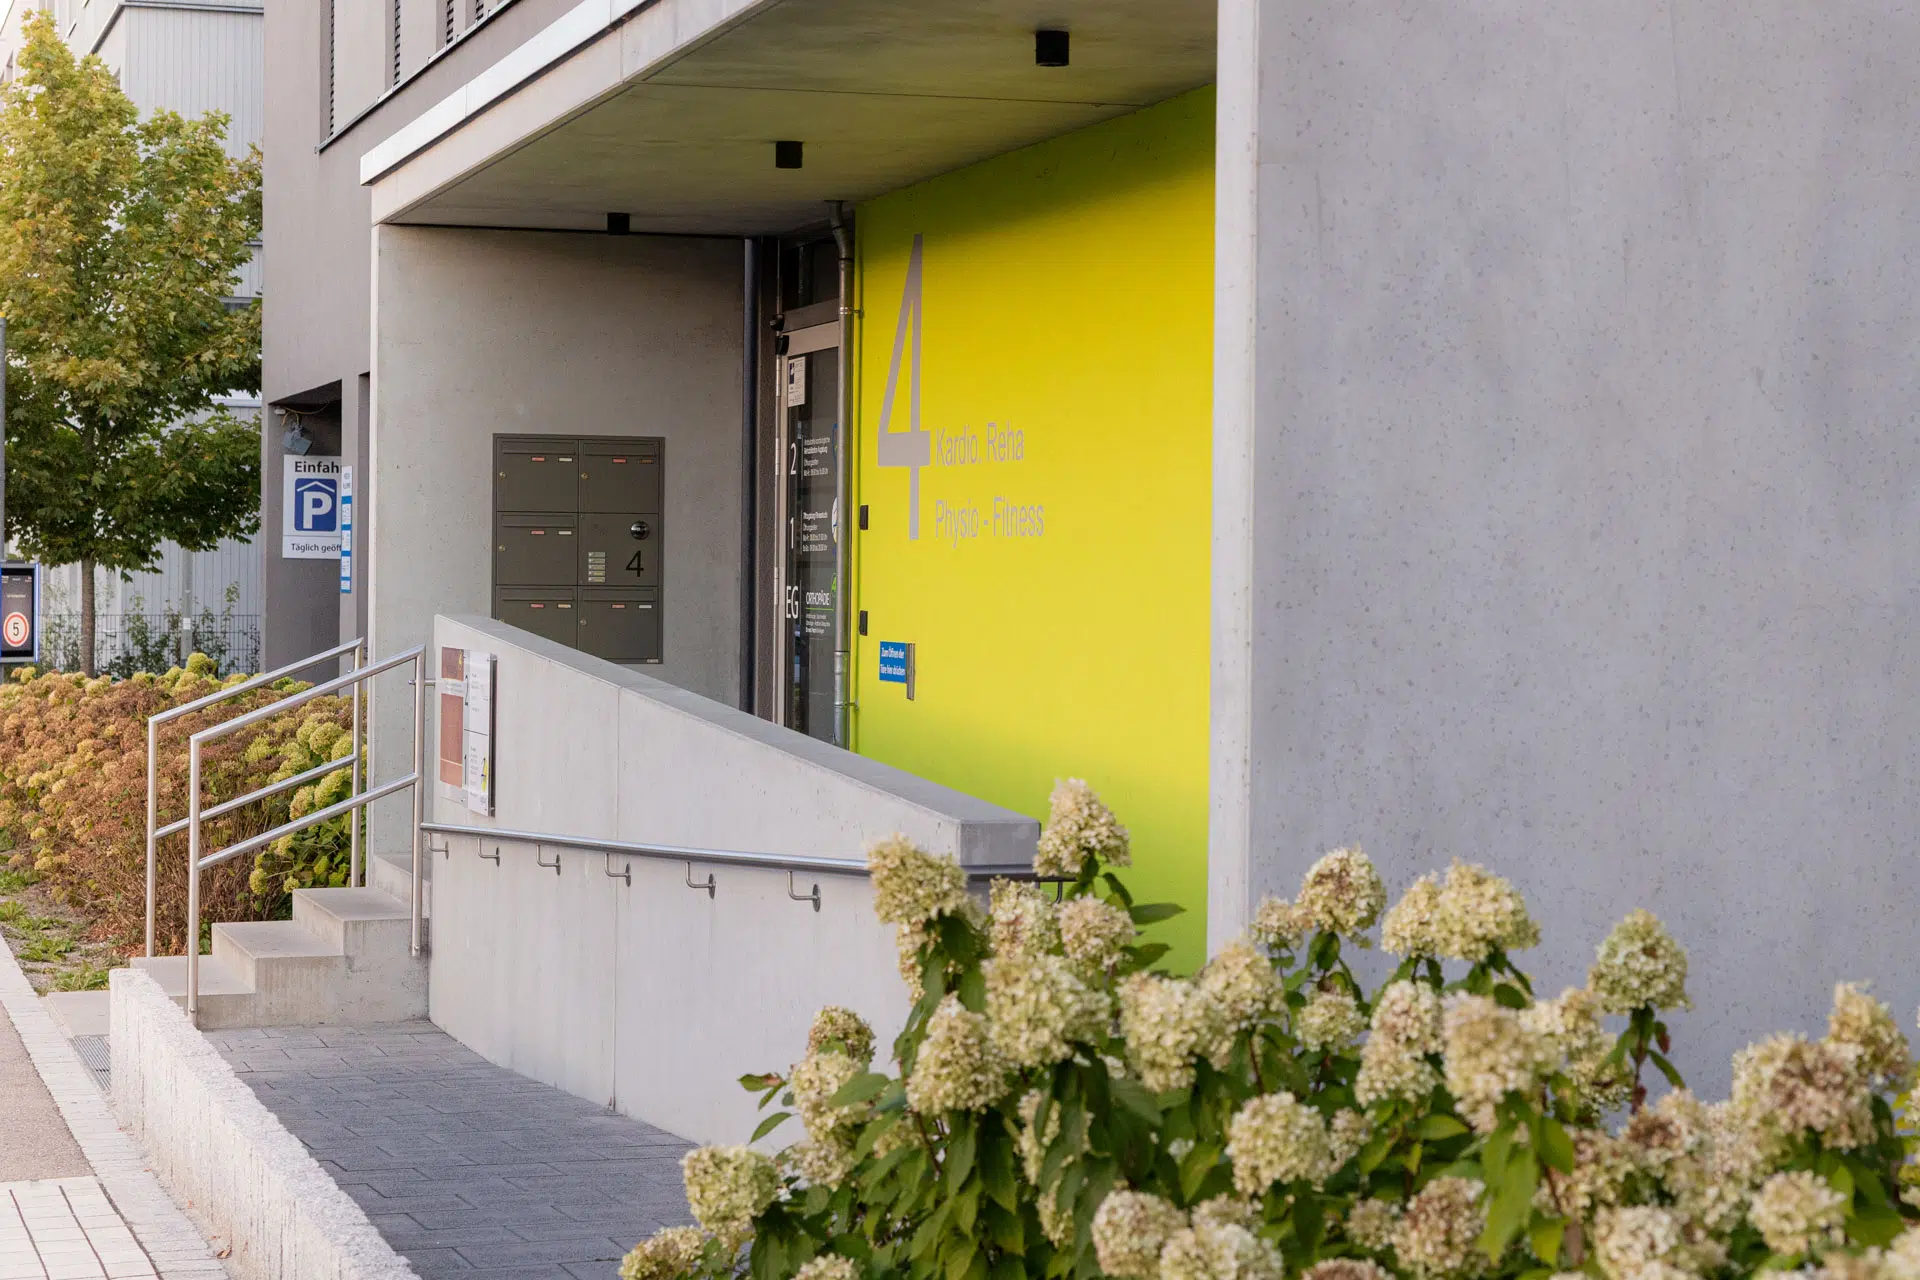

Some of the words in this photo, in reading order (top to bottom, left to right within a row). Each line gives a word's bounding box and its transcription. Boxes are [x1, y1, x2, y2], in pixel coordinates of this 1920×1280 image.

[877, 233, 931, 540] 4
[986, 420, 1025, 462] Reha
[294, 461, 342, 474] Einfah
[790, 442, 797, 475] 2
[789, 517, 795, 550] 1
[935, 498, 979, 548] Physio
[993, 495, 1045, 538] Fitness
[291, 543, 319, 554] Täglich
[625, 550, 644, 578] 4
[786, 585, 799, 619] EG
[12, 622, 20, 637] 5
